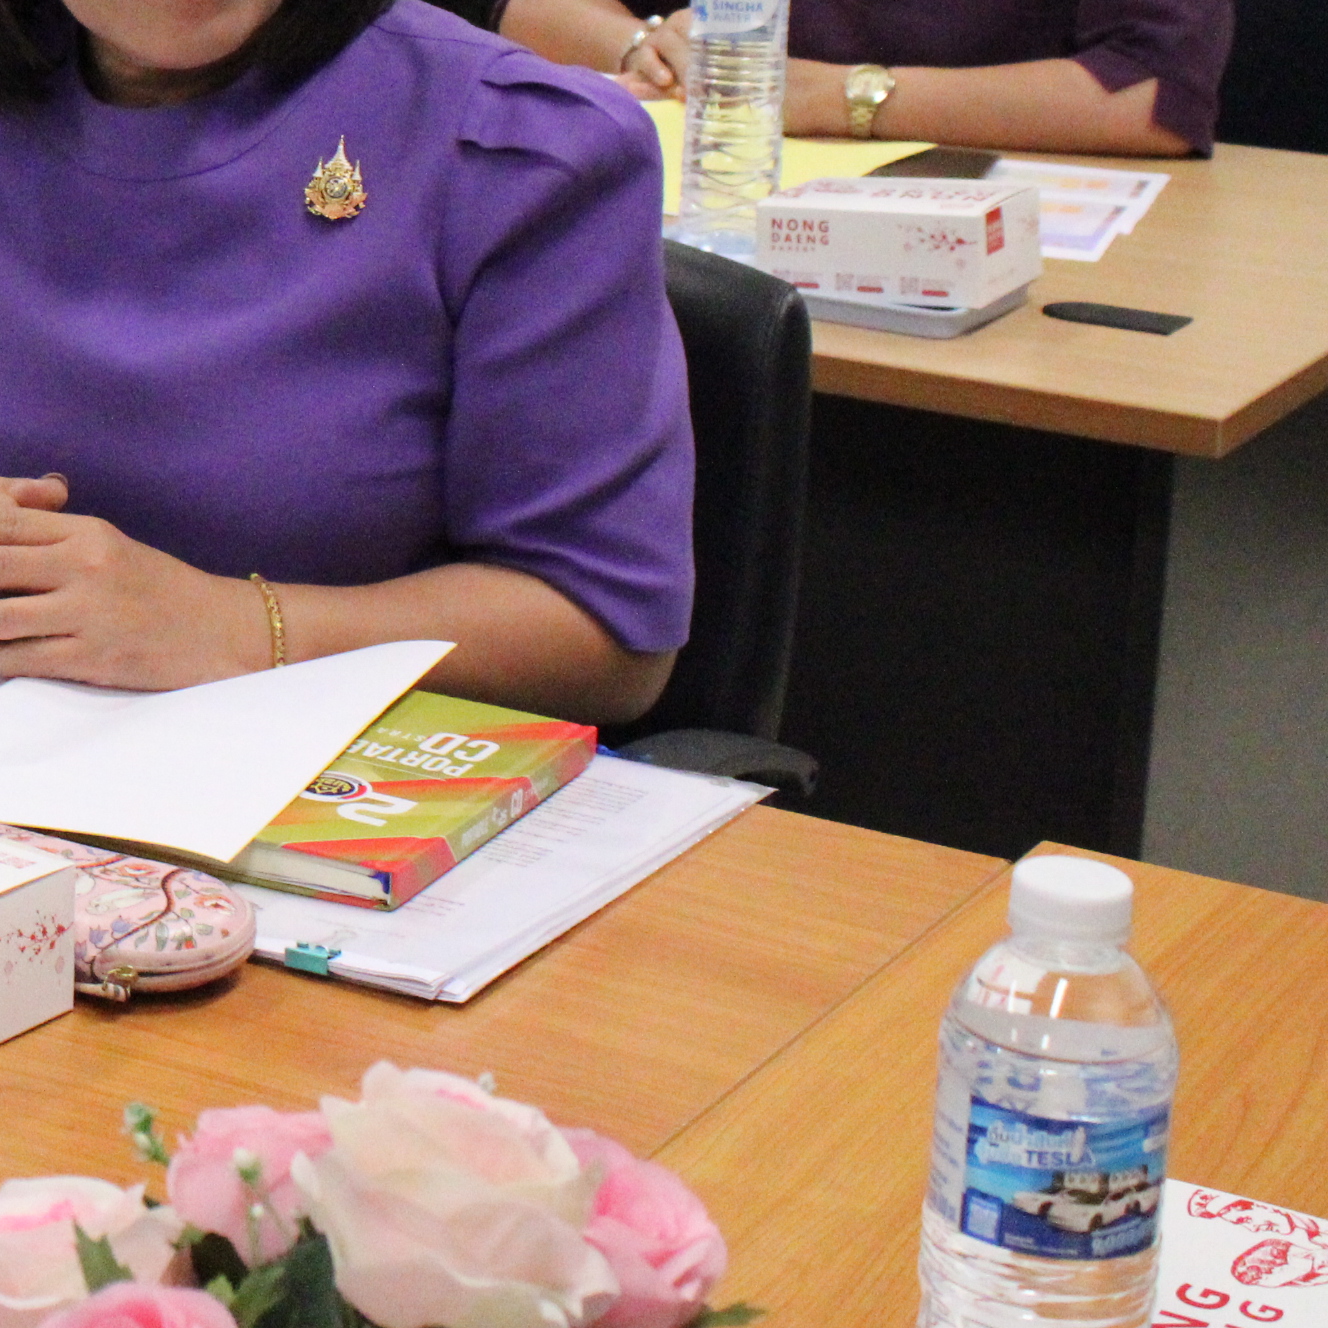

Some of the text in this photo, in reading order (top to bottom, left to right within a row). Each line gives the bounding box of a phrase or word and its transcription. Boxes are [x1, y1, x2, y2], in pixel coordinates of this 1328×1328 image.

[712, 0, 764, 12] SINGHA
[771, 218, 830, 233] NONG
[771, 232, 830, 246] DAENG
[419, 732, 501, 762] CD
